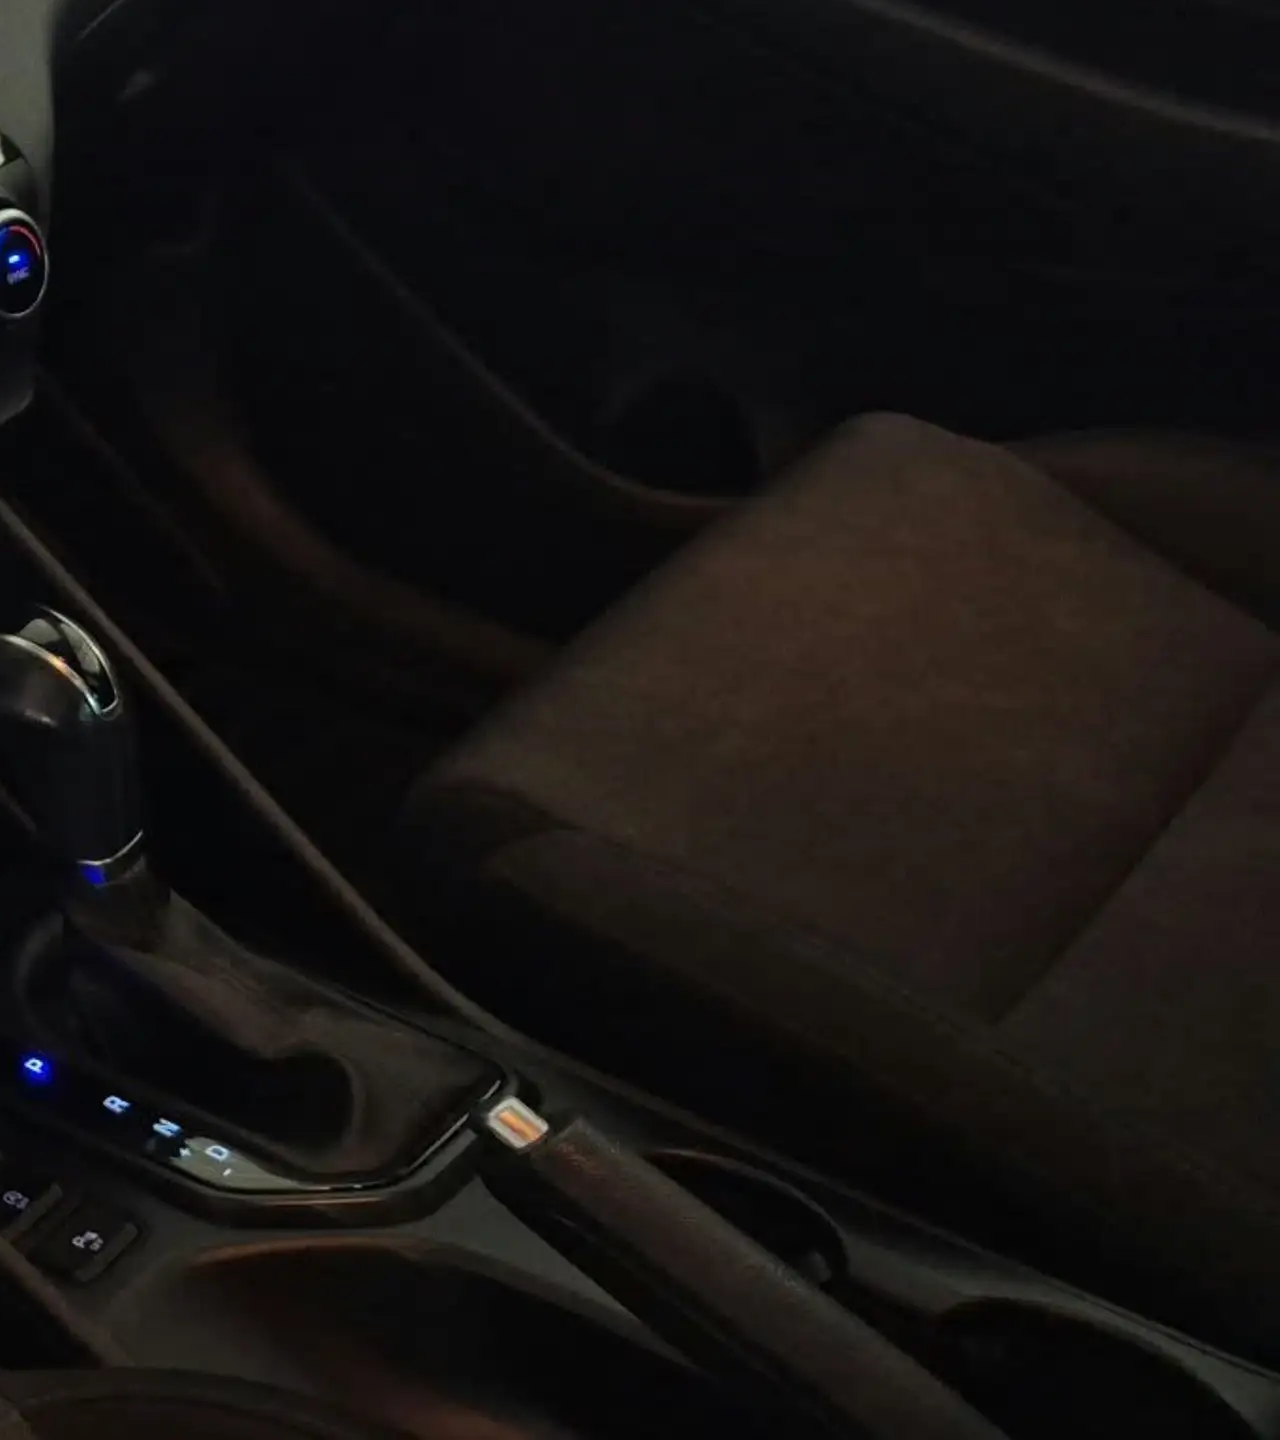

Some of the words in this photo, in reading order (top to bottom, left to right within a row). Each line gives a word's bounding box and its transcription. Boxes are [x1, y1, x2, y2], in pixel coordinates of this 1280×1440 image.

[24, 1058, 44, 1074] P
[102, 1095, 131, 1114] R
[152, 1118, 183, 1137] N
[205, 1145, 230, 1161] D
